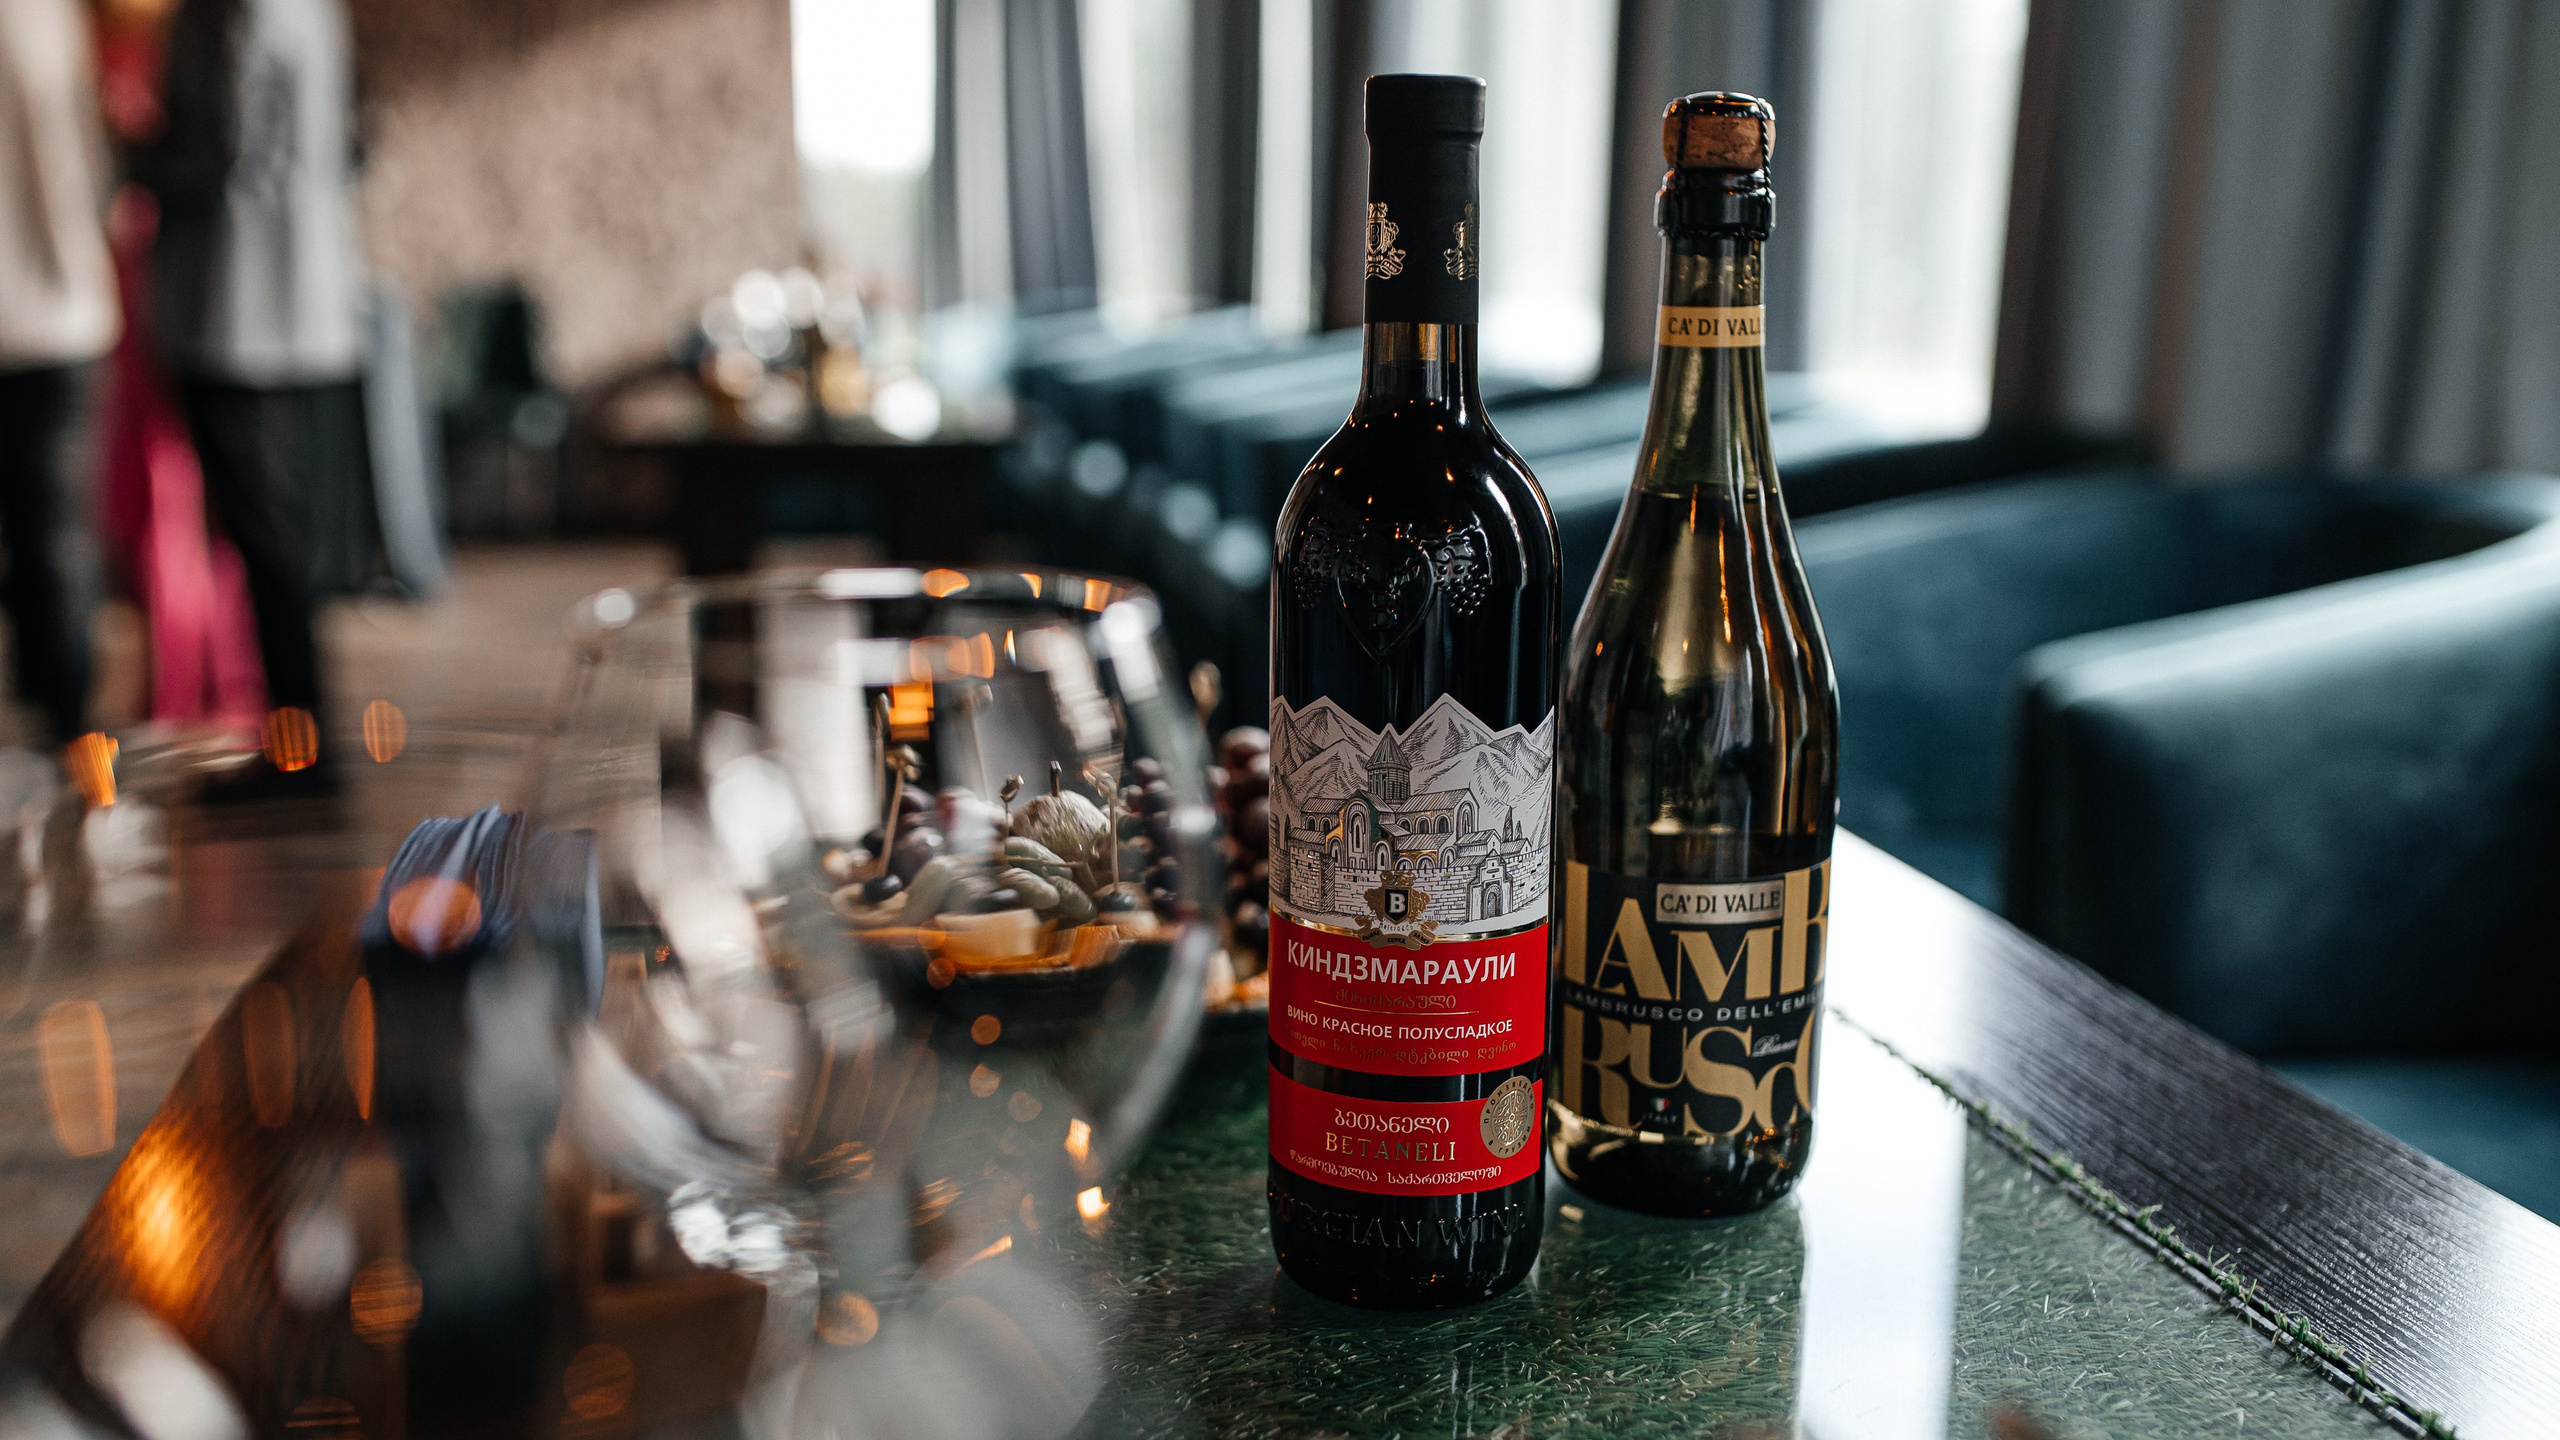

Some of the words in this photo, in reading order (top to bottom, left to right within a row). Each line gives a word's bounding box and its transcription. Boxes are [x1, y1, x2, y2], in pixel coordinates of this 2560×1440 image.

[1668, 318, 1692, 336] CA'
[1698, 319, 1719, 337] DI
[1389, 892, 1406, 914] B
[1660, 893, 1691, 913] CA'
[1696, 895, 1717, 913] DI
[1724, 890, 1781, 913] VALLE
[1287, 938, 1516, 985] КИНДЗМАРАУЛИ
[1566, 988, 1704, 1022] LAMBRUSCO
[1287, 1004, 1318, 1026] ВИНО
[1323, 1018, 1393, 1039] КРАСНОЕ
[1398, 1019, 1513, 1040] ПОЛУСЛАДКОЕ
[1334, 1108, 1450, 1134] ბეთანელი
[1325, 1131, 1455, 1162] BETANELI
[1388, 1165, 1502, 1186] საქართველოში
